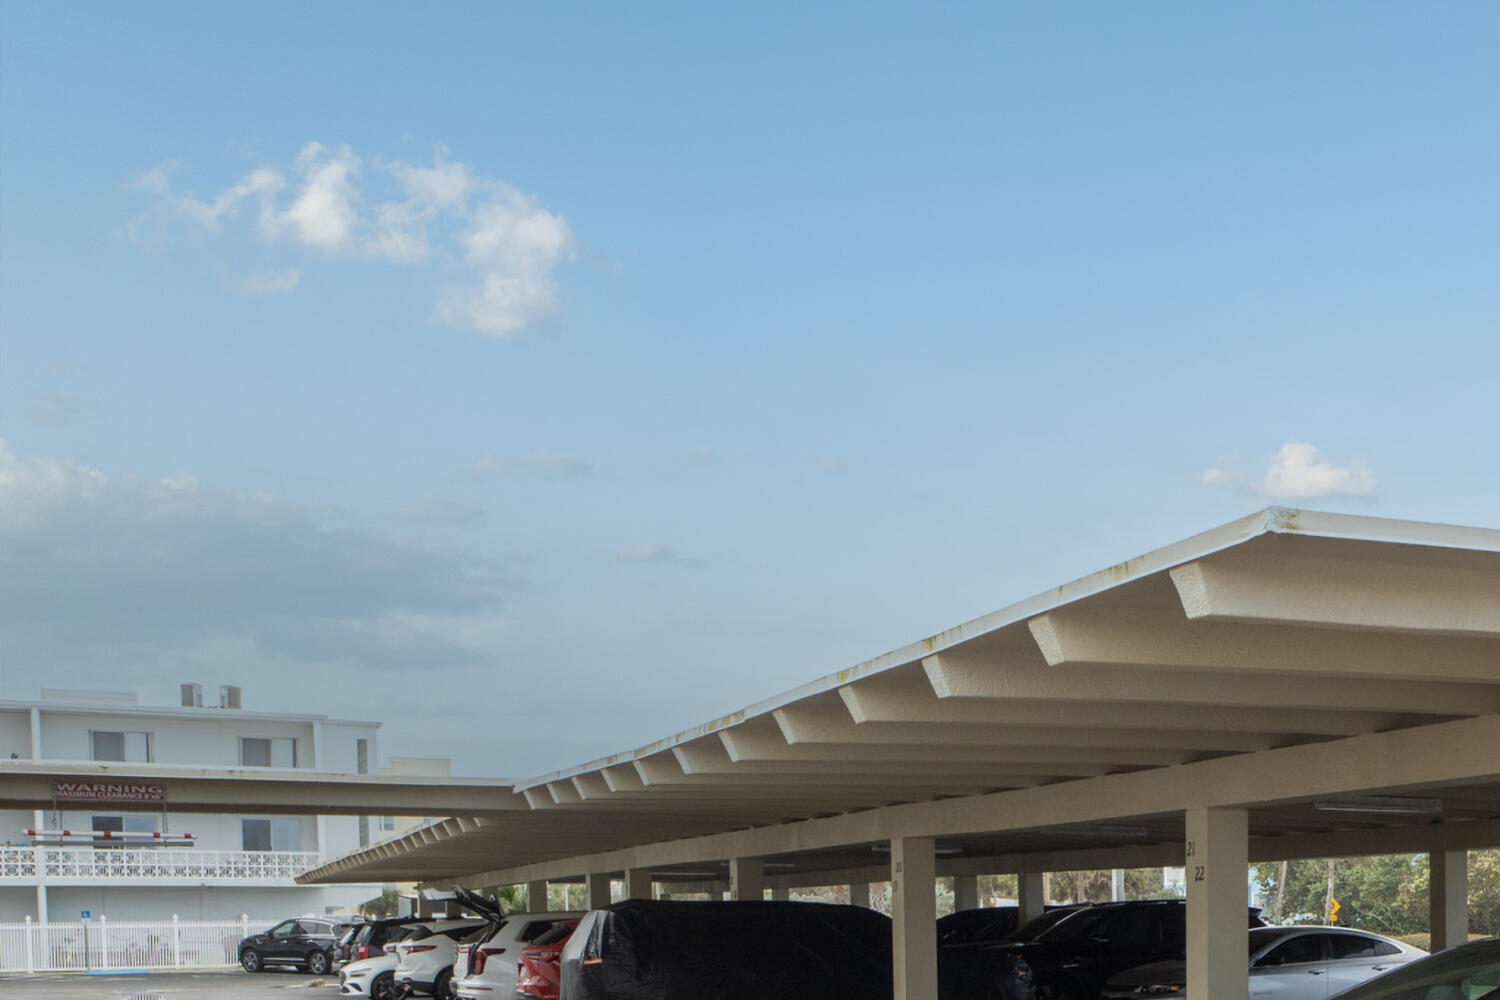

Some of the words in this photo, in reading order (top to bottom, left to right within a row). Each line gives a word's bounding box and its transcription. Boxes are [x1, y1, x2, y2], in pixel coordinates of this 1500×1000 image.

[57, 783, 162, 793] WARNING
[56, 790, 96, 798] MAXIMUM
[97, 791, 143, 800] CLEARANCE
[1194, 866, 1205, 881] 22
